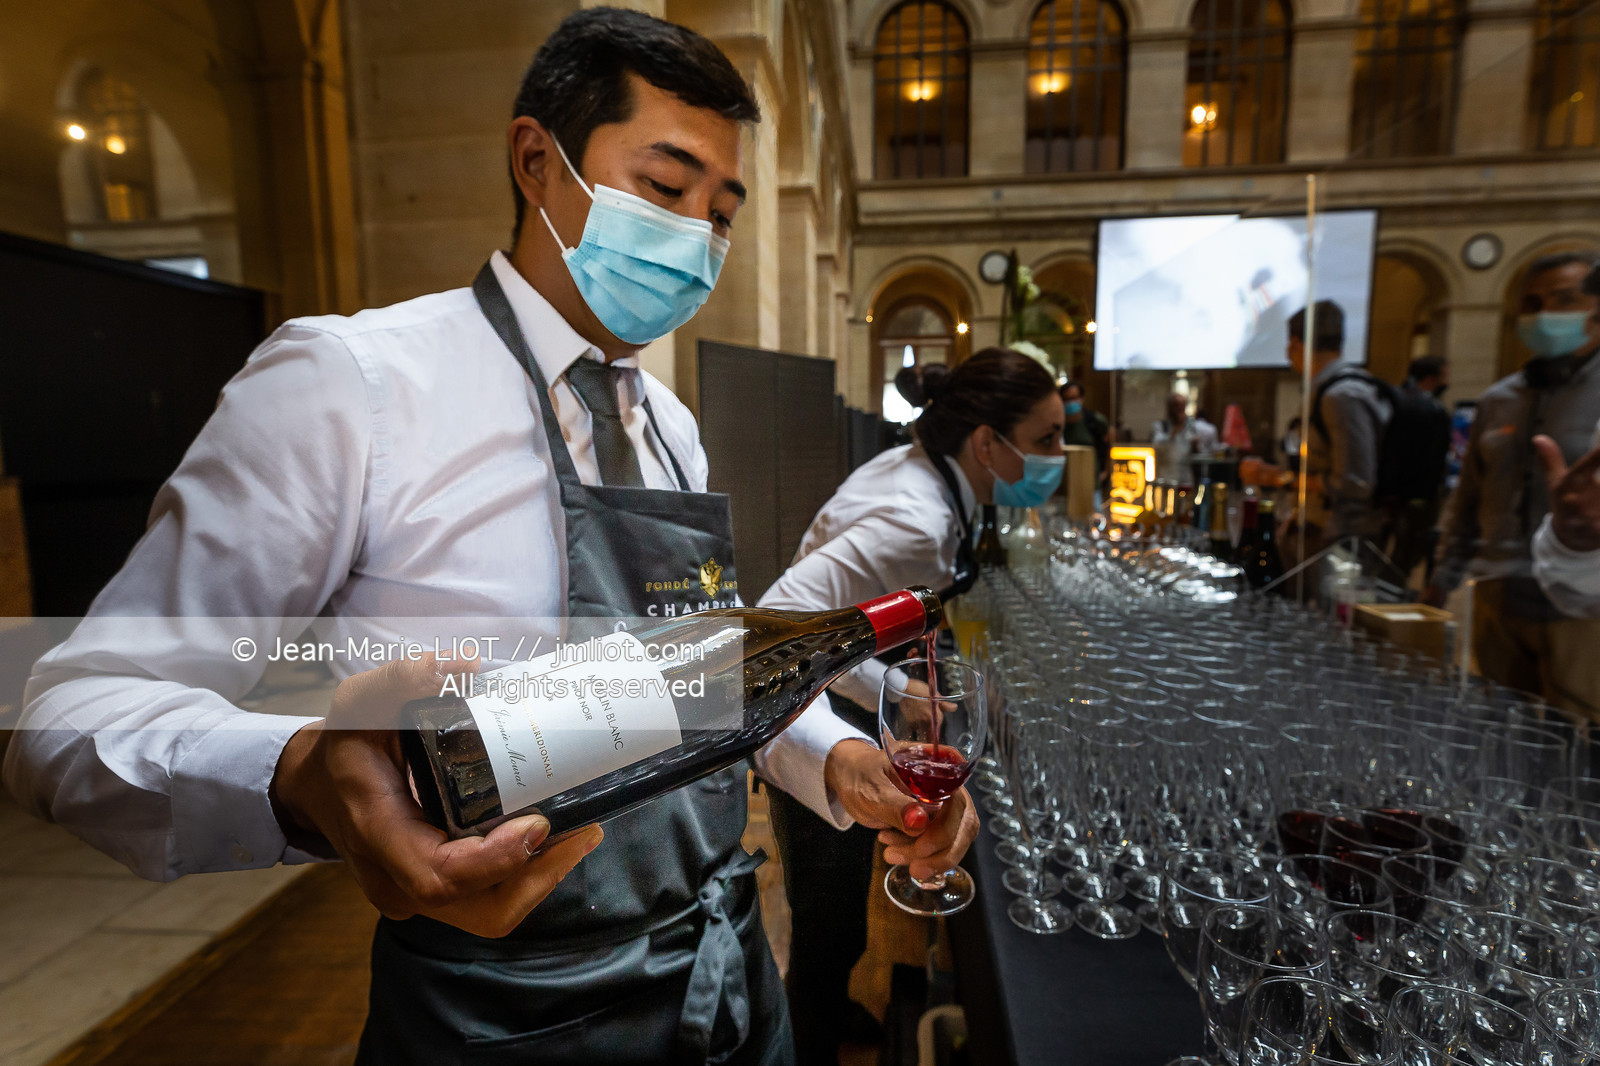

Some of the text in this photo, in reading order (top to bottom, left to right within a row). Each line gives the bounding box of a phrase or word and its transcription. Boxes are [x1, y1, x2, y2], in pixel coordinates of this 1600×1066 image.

[571, 680, 593, 722] PINOT NOIR
[605, 712, 624, 751] BLANC
